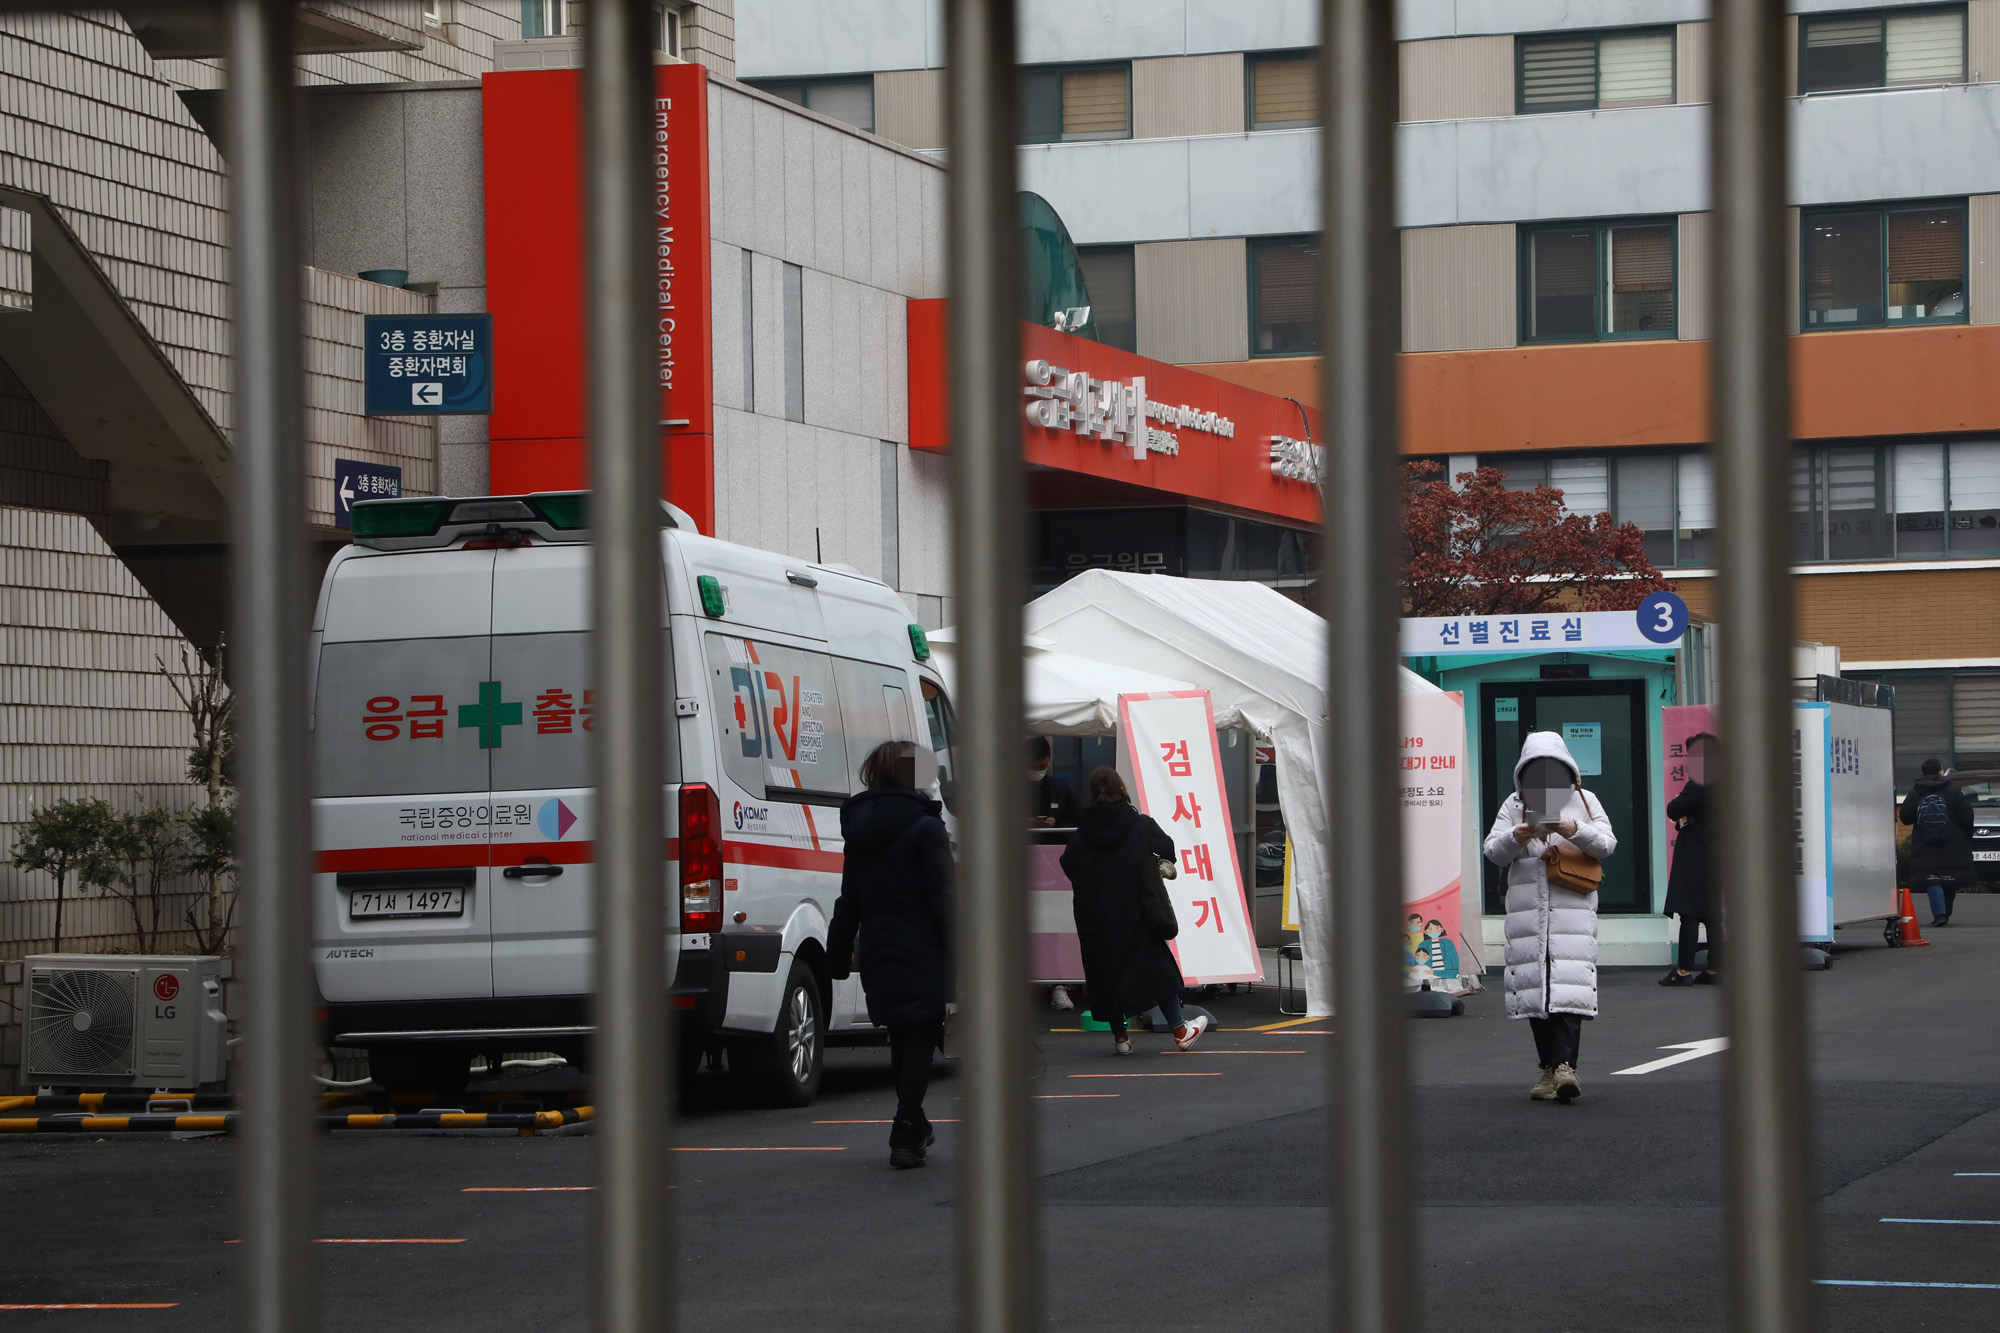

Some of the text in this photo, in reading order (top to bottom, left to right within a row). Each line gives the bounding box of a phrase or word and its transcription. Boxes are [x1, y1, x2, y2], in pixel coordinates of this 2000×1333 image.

[655, 97, 676, 390] Emergency Medical Center
[380, 330, 474, 351] 3층 중환자실
[388, 356, 467, 378] 중환자면회
[1024, 360, 1147, 460] 응급의료센터
[357, 473, 398, 496] 3층 중환자실
[1653, 602, 1674, 633] 3
[1439, 617, 1583, 646] 선별진료실
[802, 690, 824, 703] DISASTER
[362, 695, 448, 741] 응급
[802, 705, 812, 718] AND
[801, 720, 824, 734] INFECTION
[800, 735, 823, 749] RESPONSE
[799, 750, 818, 764] VEHICLE
[1430, 755, 1456, 770] 안내
[1427, 786, 1445, 796] 소요
[398, 803, 532, 829] 국립중앙의료원
[401, 830, 513, 842] national medical center
[361, 891, 453, 912] 71서 1497
[326, 948, 374, 959] AUTECH
[155, 1005, 176, 1019] LG
